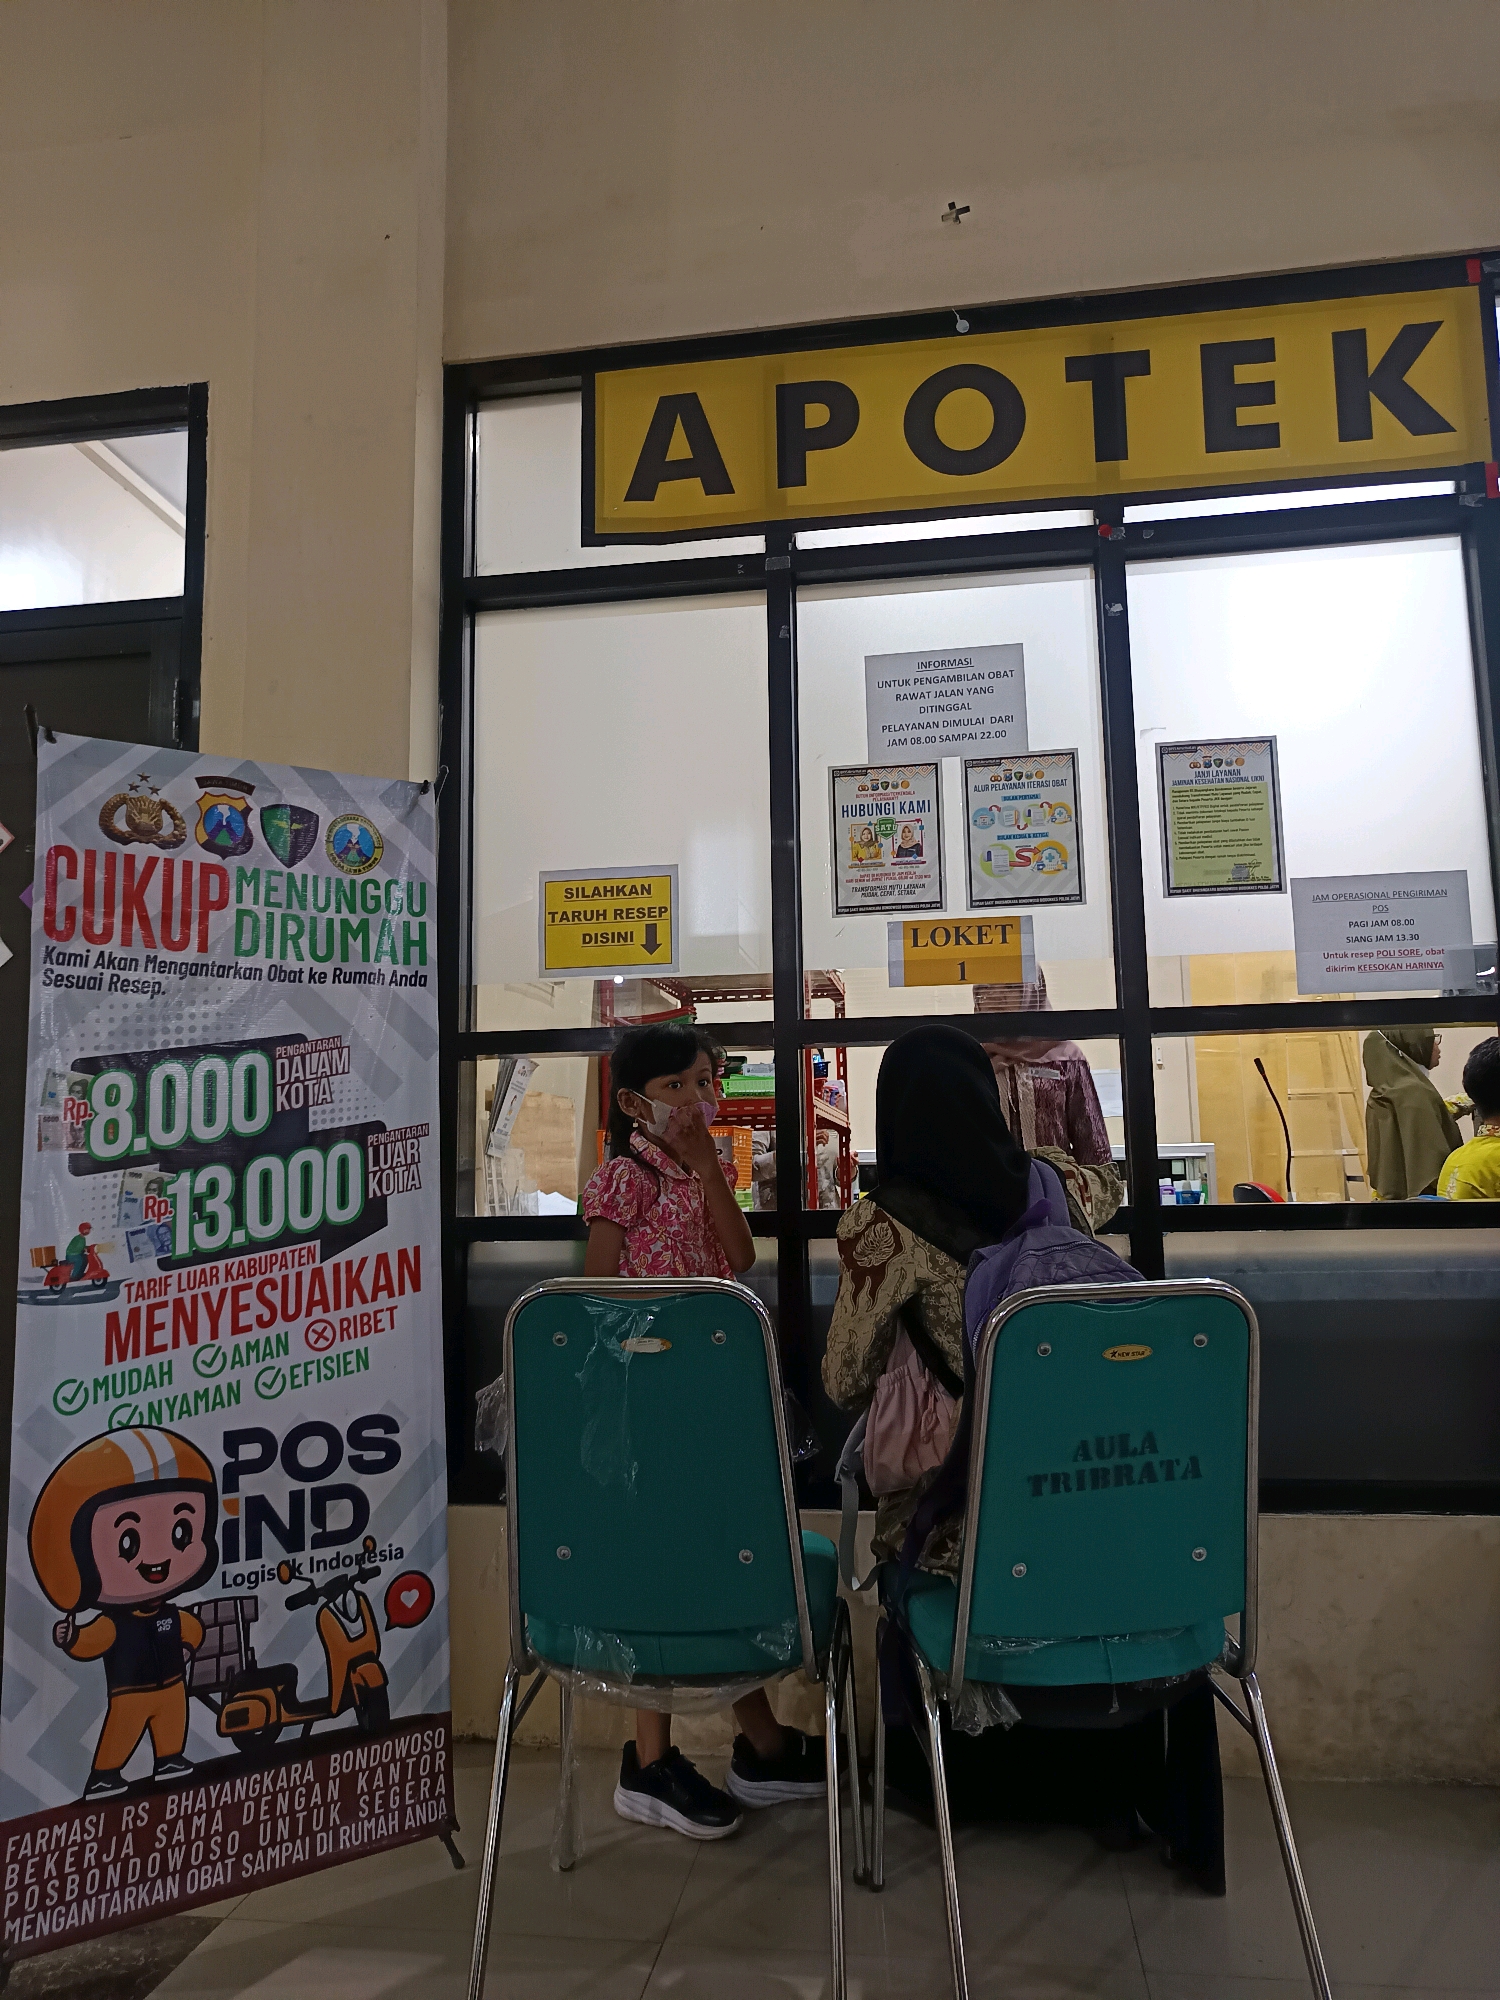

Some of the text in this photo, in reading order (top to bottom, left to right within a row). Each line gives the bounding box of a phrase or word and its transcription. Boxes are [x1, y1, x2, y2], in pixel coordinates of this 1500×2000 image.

[623, 319, 1458, 504] APOTEK
[877, 669, 1015, 689] UNTUK PENGAMBILAN OBAT
[917, 658, 972, 670] INFORMASI
[895, 686, 994, 702] RAWAT JALAN YANG
[919, 703, 972, 714] DITINGGAL
[882, 715, 1014, 733] PELAYANAN DIMULAI DARI
[887, 730, 1007, 748] JAM 08.00 SAMPAI 22.00
[974, 784, 990, 792] ALUR
[990, 782, 1026, 791] PELAYANAN
[1052, 779, 1068, 787] OBAT
[1194, 769, 1241, 778] JANJI LAYANAN
[842, 800, 930, 818] HUBUNGI KAMI
[42, 844, 230, 954] CUKUP
[235, 865, 427, 918] MENUNGGU
[564, 884, 652, 899] SILAHKAN
[1312, 889, 1448, 902] JAM OPERASIONAL PENGIRIMAN
[548, 906, 668, 923] TARUH RESEP
[1349, 920, 1369, 928] PAGI
[1370, 920, 1388, 928] JAM
[1372, 904, 1389, 913] POS
[234, 909, 428, 967] DIRUMAH
[582, 931, 634, 945] DISINI
[910, 924, 1013, 948] LOKET
[1346, 936, 1372, 944] SIANG
[1396, 934, 1420, 942] 13.30
[42, 945, 428, 988] Kami Akan Mengantarkan Obat ke Rumah Anda
[1323, 951, 1348, 959] Untuk
[1351, 952, 1374, 960] resep
[1398, 949, 1423, 958] SORE,
[1426, 948, 1445, 956] obat
[1326, 962, 1444, 972] dikirim KEESOKAN HARINYA
[42, 968, 166, 1000] Sesuai Resep.
[957, 961, 967, 981] 1
[276, 1036, 341, 1058] PENGANTARAN
[276, 1048, 350, 1085] DALAM
[63, 1051, 272, 1160] Rp. 8.000
[276, 1077, 333, 1113] KOTA
[367, 1123, 429, 1147] PENGANTARAN
[368, 1139, 421, 1172] LUAR
[368, 1166, 421, 1199] KOTA
[144, 1141, 364, 1259] Rp. 13.000
[124, 1249, 317, 1304] TARIF LUAR KABUPATEN
[104, 1245, 422, 1367] MENYESUAIKAN
[92, 1305, 398, 1405] MUDAH AMAN RIBET
[148, 1346, 370, 1426] NYAMAN EFISIEN
[222, 1413, 401, 1494] POS
[1073, 1431, 1159, 1462] AULA
[1027, 1456, 1203, 1497] TRIBRATA
[222, 1543, 405, 1591] Logisk Indonesia
[6, 1727, 445, 1863] FARMASI RS BHAYANGKARA BONDOWOSO
[5, 1751, 445, 1890] BEKERJA SAMA DENGAN KANTOR
[4, 1774, 446, 1919] POSBONDOWOSO UNTUK SEGERA
[4, 1797, 449, 1945] MENGANTARKAN OBAT SAMPAI DI RUMAH ANDA
